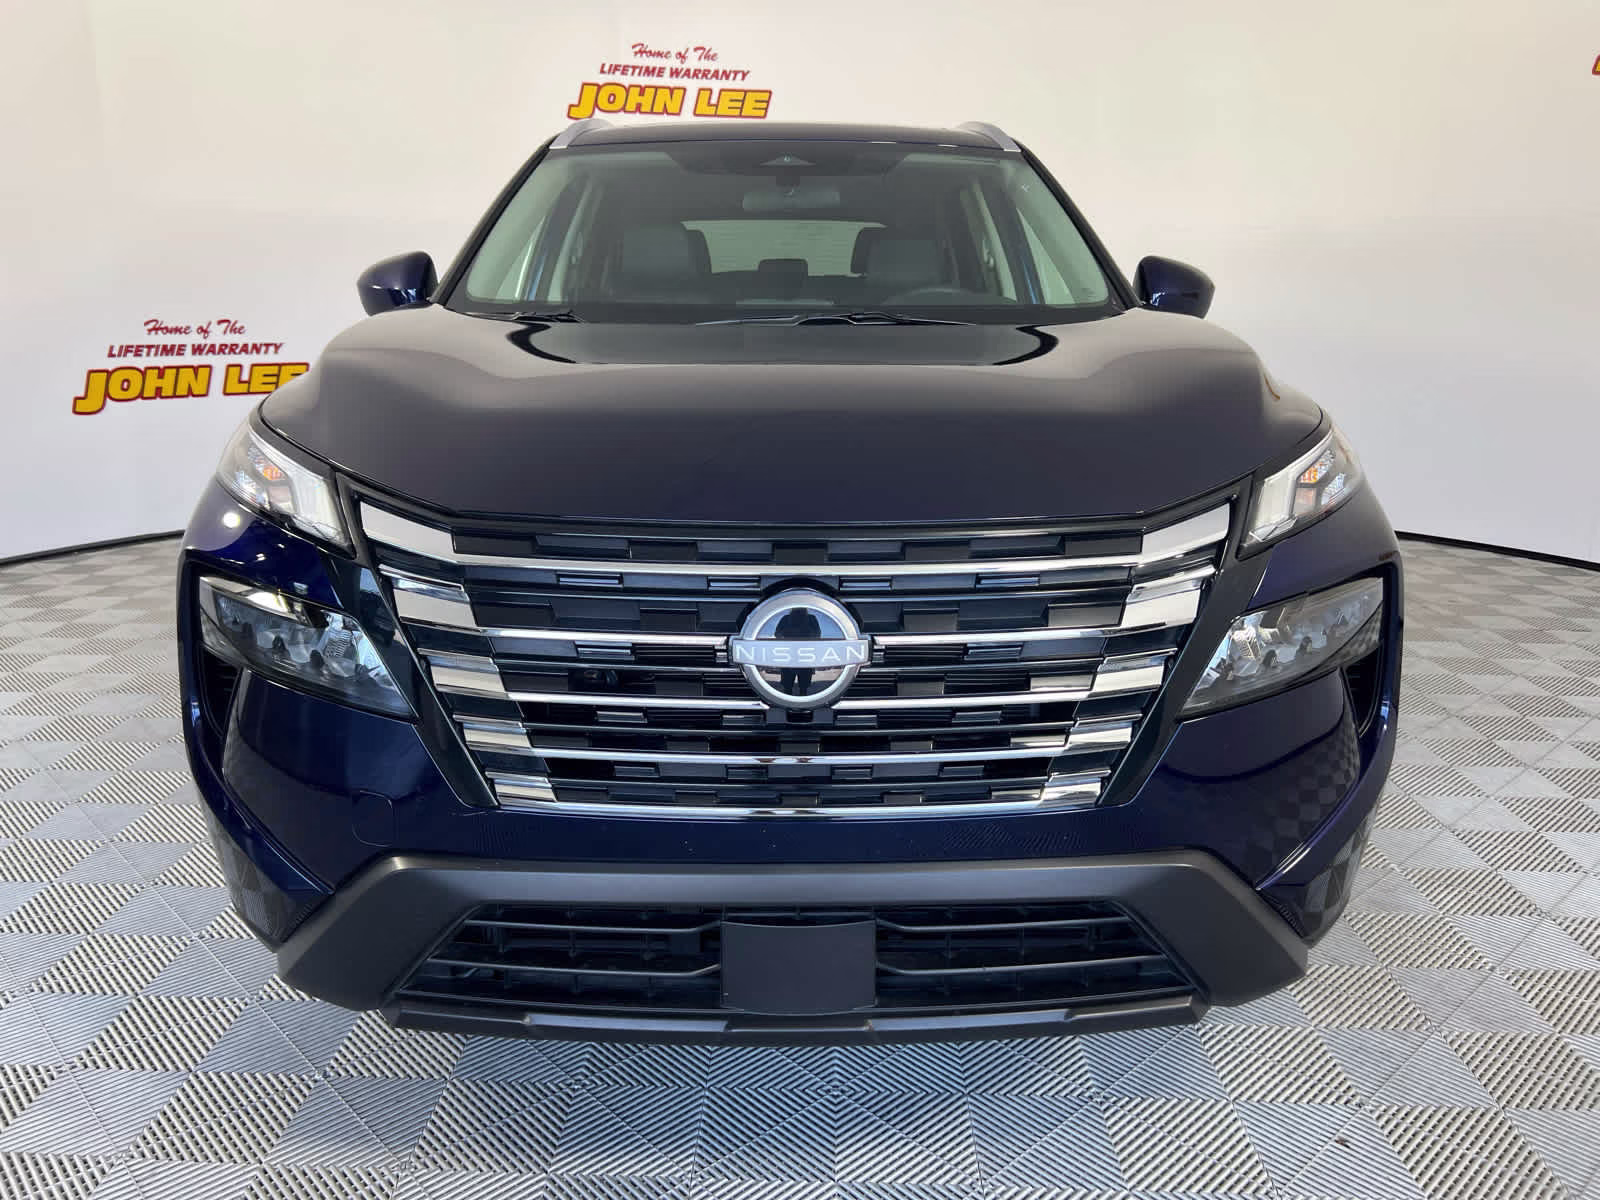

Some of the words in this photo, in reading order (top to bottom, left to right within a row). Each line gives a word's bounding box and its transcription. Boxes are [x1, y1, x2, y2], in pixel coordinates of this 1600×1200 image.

[631, 43, 672, 59] Home
[675, 48, 689, 63] of
[693, 46, 718, 61] The
[600, 63, 666, 78] LIFETIME
[669, 67, 750, 81] WARRANTY
[567, 82, 686, 120] JOHN
[693, 88, 772, 118] LEE
[143, 319, 192, 336] Home
[196, 321, 212, 339] of
[217, 319, 246, 335] The
[107, 344, 187, 358] LIFETIME
[191, 342, 284, 356] WARRANTY
[72, 364, 212, 414] JOHN
[735, 644, 865, 663] NISSAN
